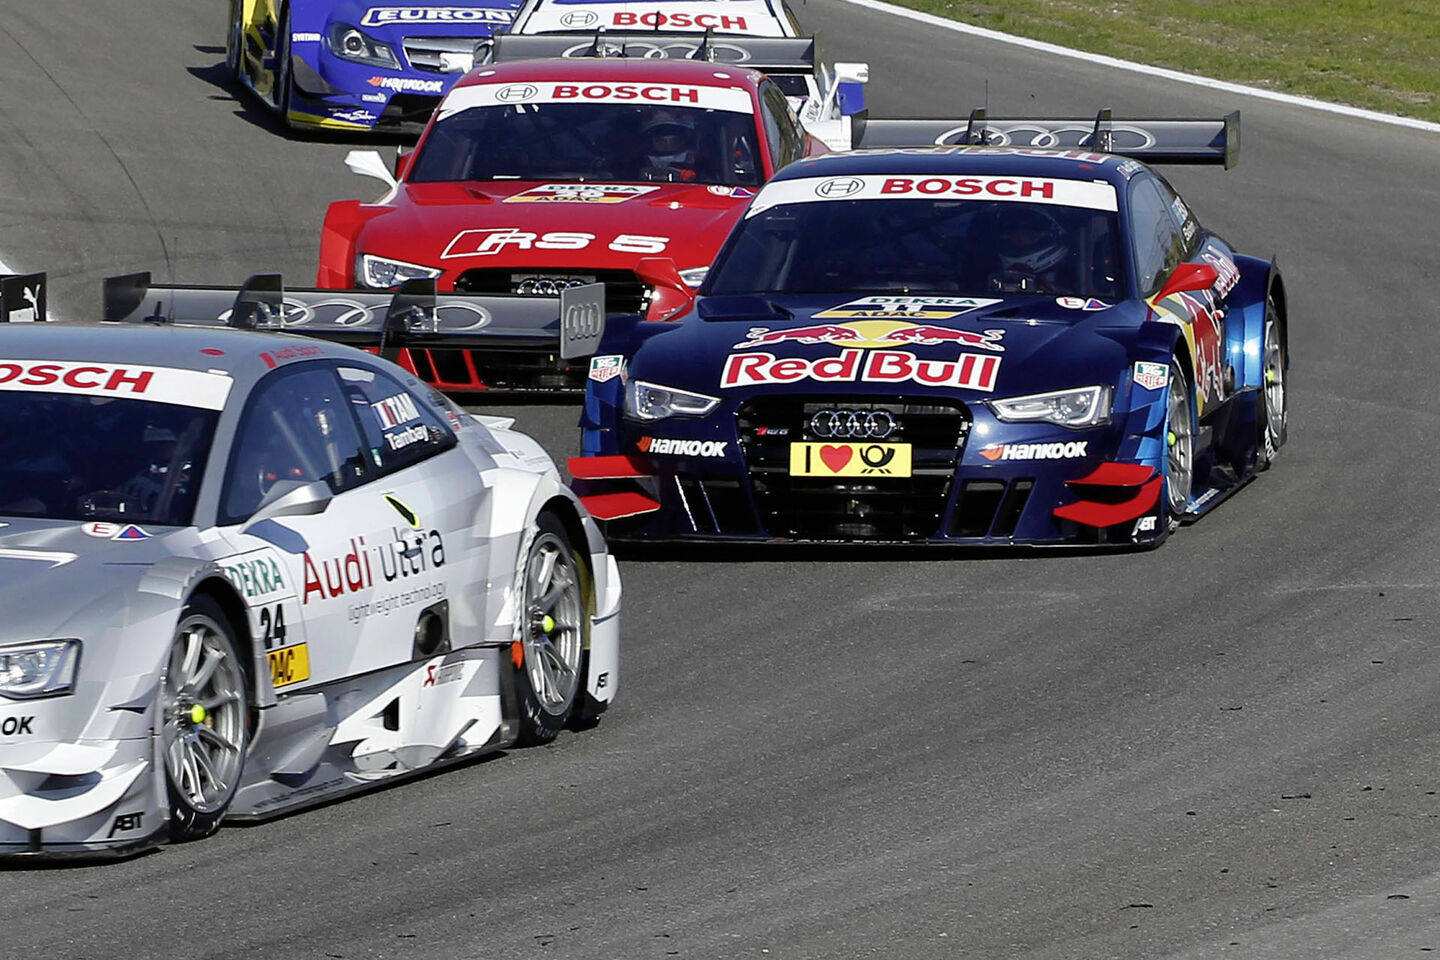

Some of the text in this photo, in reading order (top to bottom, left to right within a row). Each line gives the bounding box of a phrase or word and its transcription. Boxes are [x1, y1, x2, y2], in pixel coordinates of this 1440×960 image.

[376, 9, 517, 22] EURON
[612, 11, 749, 31] BOSCH
[380, 76, 444, 93] Hankook
[551, 85, 699, 103] BOSCH
[880, 177, 1054, 199] BOSCH
[608, 234, 671, 254] 5
[869, 297, 979, 306] DEKRA
[723, 349, 1002, 391] Red Bull
[384, 424, 429, 451] Tambay
[303, 526, 447, 605] Audi ultra
[225, 556, 286, 598] DEKRA
[260, 603, 287, 647] 24
[111, 811, 146, 837] ABT
